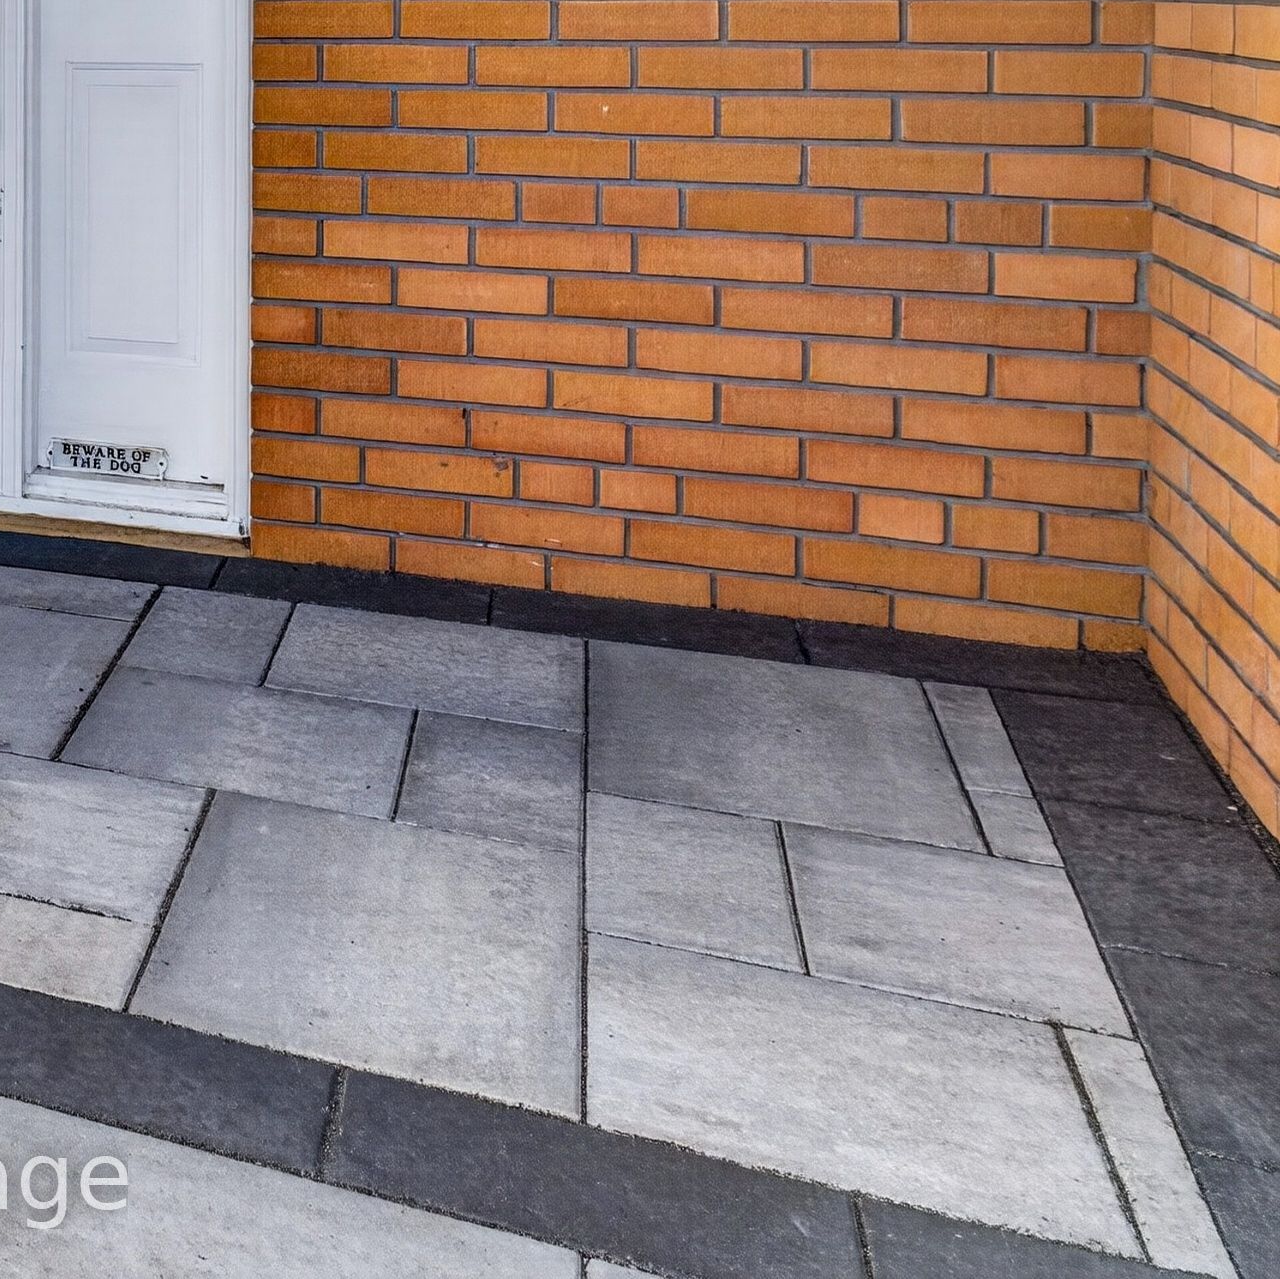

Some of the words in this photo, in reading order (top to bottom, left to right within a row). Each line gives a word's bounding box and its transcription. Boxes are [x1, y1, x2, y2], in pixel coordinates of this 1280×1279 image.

[62, 443, 126, 460] BEWARE
[131, 450, 151, 462] OF
[70, 456, 101, 470] THE
[110, 460, 141, 474] DOG
